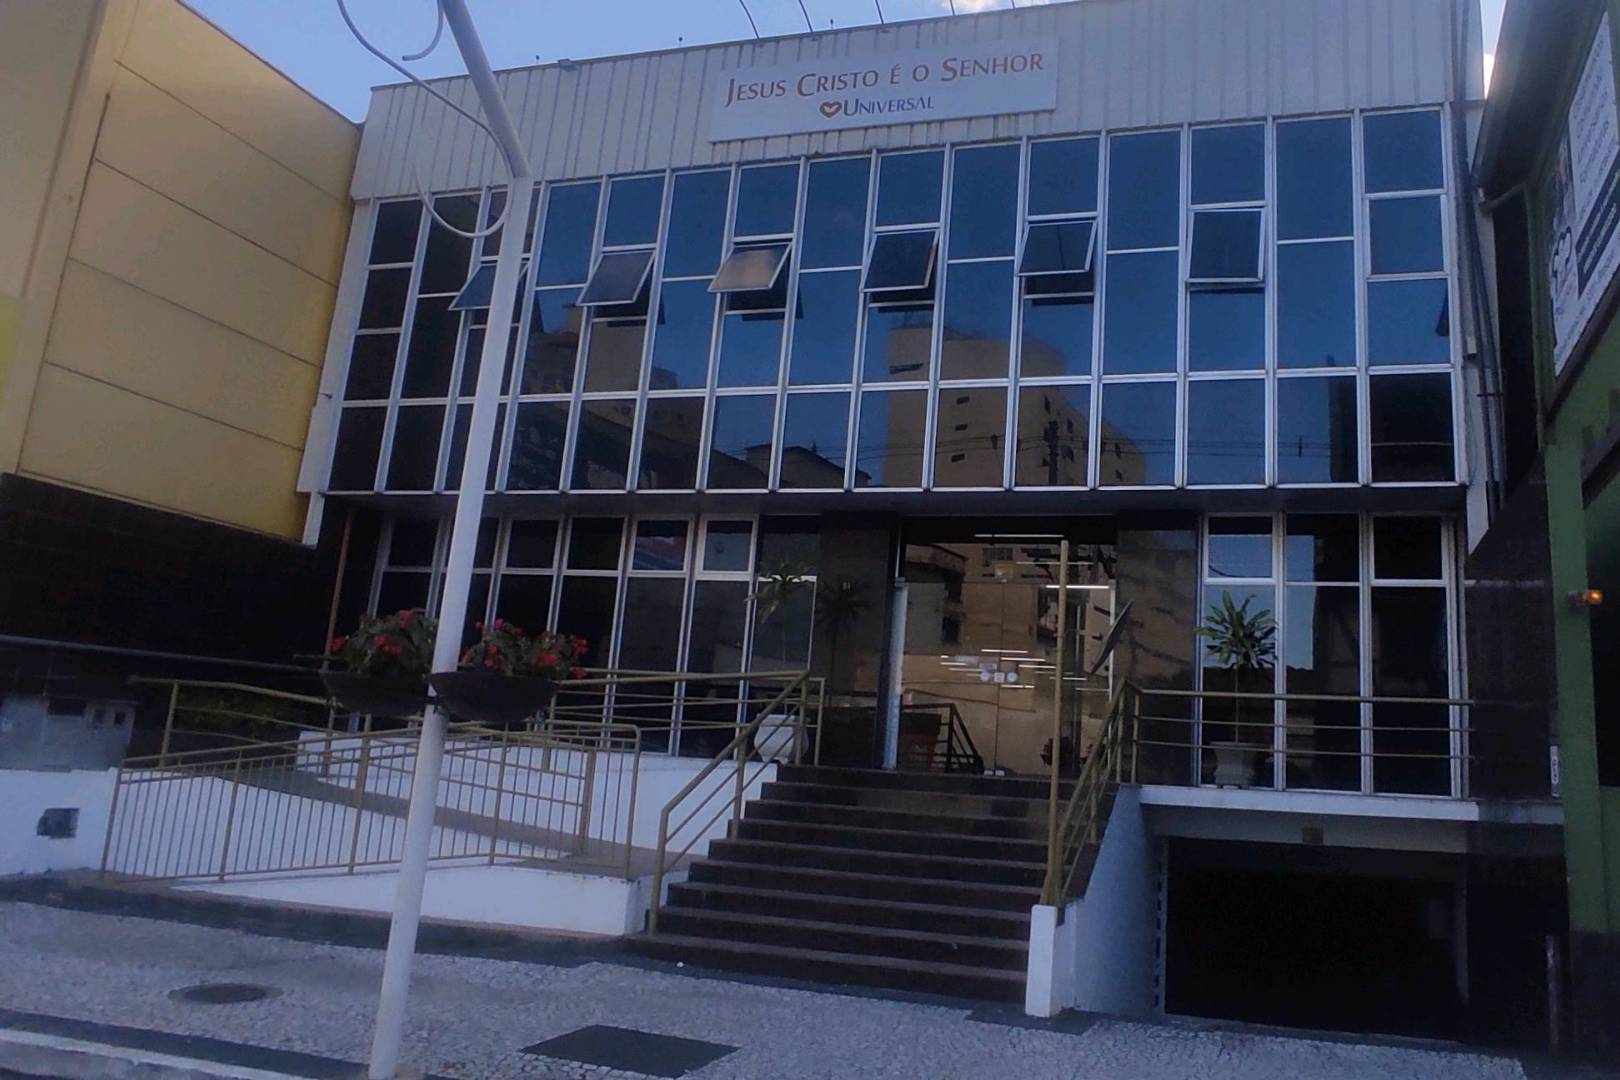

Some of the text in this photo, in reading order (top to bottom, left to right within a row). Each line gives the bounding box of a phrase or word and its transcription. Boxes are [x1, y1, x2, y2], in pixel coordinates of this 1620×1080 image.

[725, 53, 1045, 108] JESUS CRISTO É O SENHOR
[842, 96, 935, 118] UNIVERSAL
